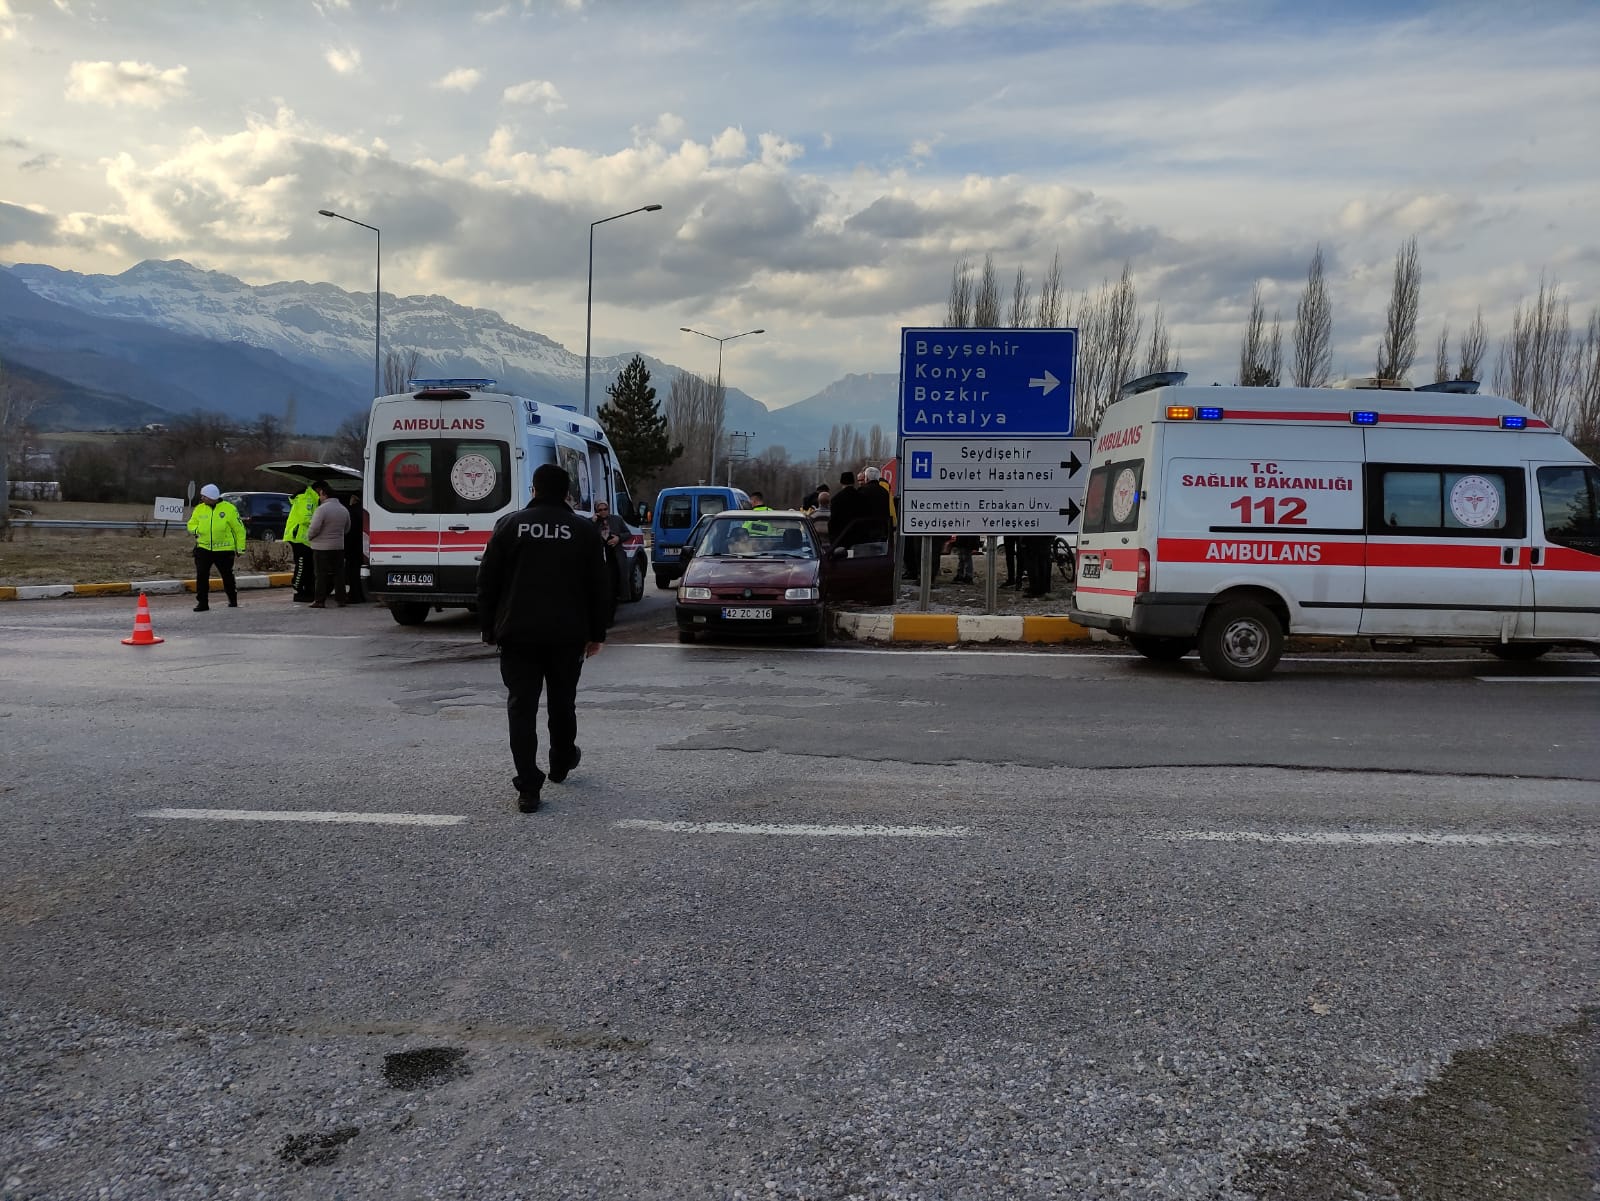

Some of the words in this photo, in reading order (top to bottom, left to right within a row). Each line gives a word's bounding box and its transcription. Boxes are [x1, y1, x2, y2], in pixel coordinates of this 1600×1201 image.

[915, 340, 1020, 359] Beyşehir
[915, 363, 987, 382] Konya
[914, 386, 990, 402] Bozkır
[393, 418, 485, 431] AMBULANS
[914, 409, 1008, 427] Antalya
[1097, 425, 1143, 454] AMBULANS
[961, 446, 1032, 463] Seydişehir
[915, 458, 928, 473] H
[1251, 462, 1283, 474] T.C.
[939, 468, 982, 481] Devlet
[989, 469, 1055, 481] Hastanesi
[1182, 473, 1248, 488] SAĞLIK
[1254, 475, 1353, 491] BAKANLIĞI
[910, 499, 970, 510] Necmettin
[978, 499, 1025, 510] Erbakan
[1230, 496, 1308, 525] 112
[910, 517, 972, 529] Seydişehir
[981, 518, 1040, 529] Yerleşkesi
[1205, 541, 1322, 562] AMBULANS
[392, 574, 402, 584] 42
[403, 574, 418, 584] ALB
[418, 574, 433, 584] 400
[727, 609, 737, 618] 42
[740, 609, 751, 618] ZC
[755, 609, 771, 618] 216
